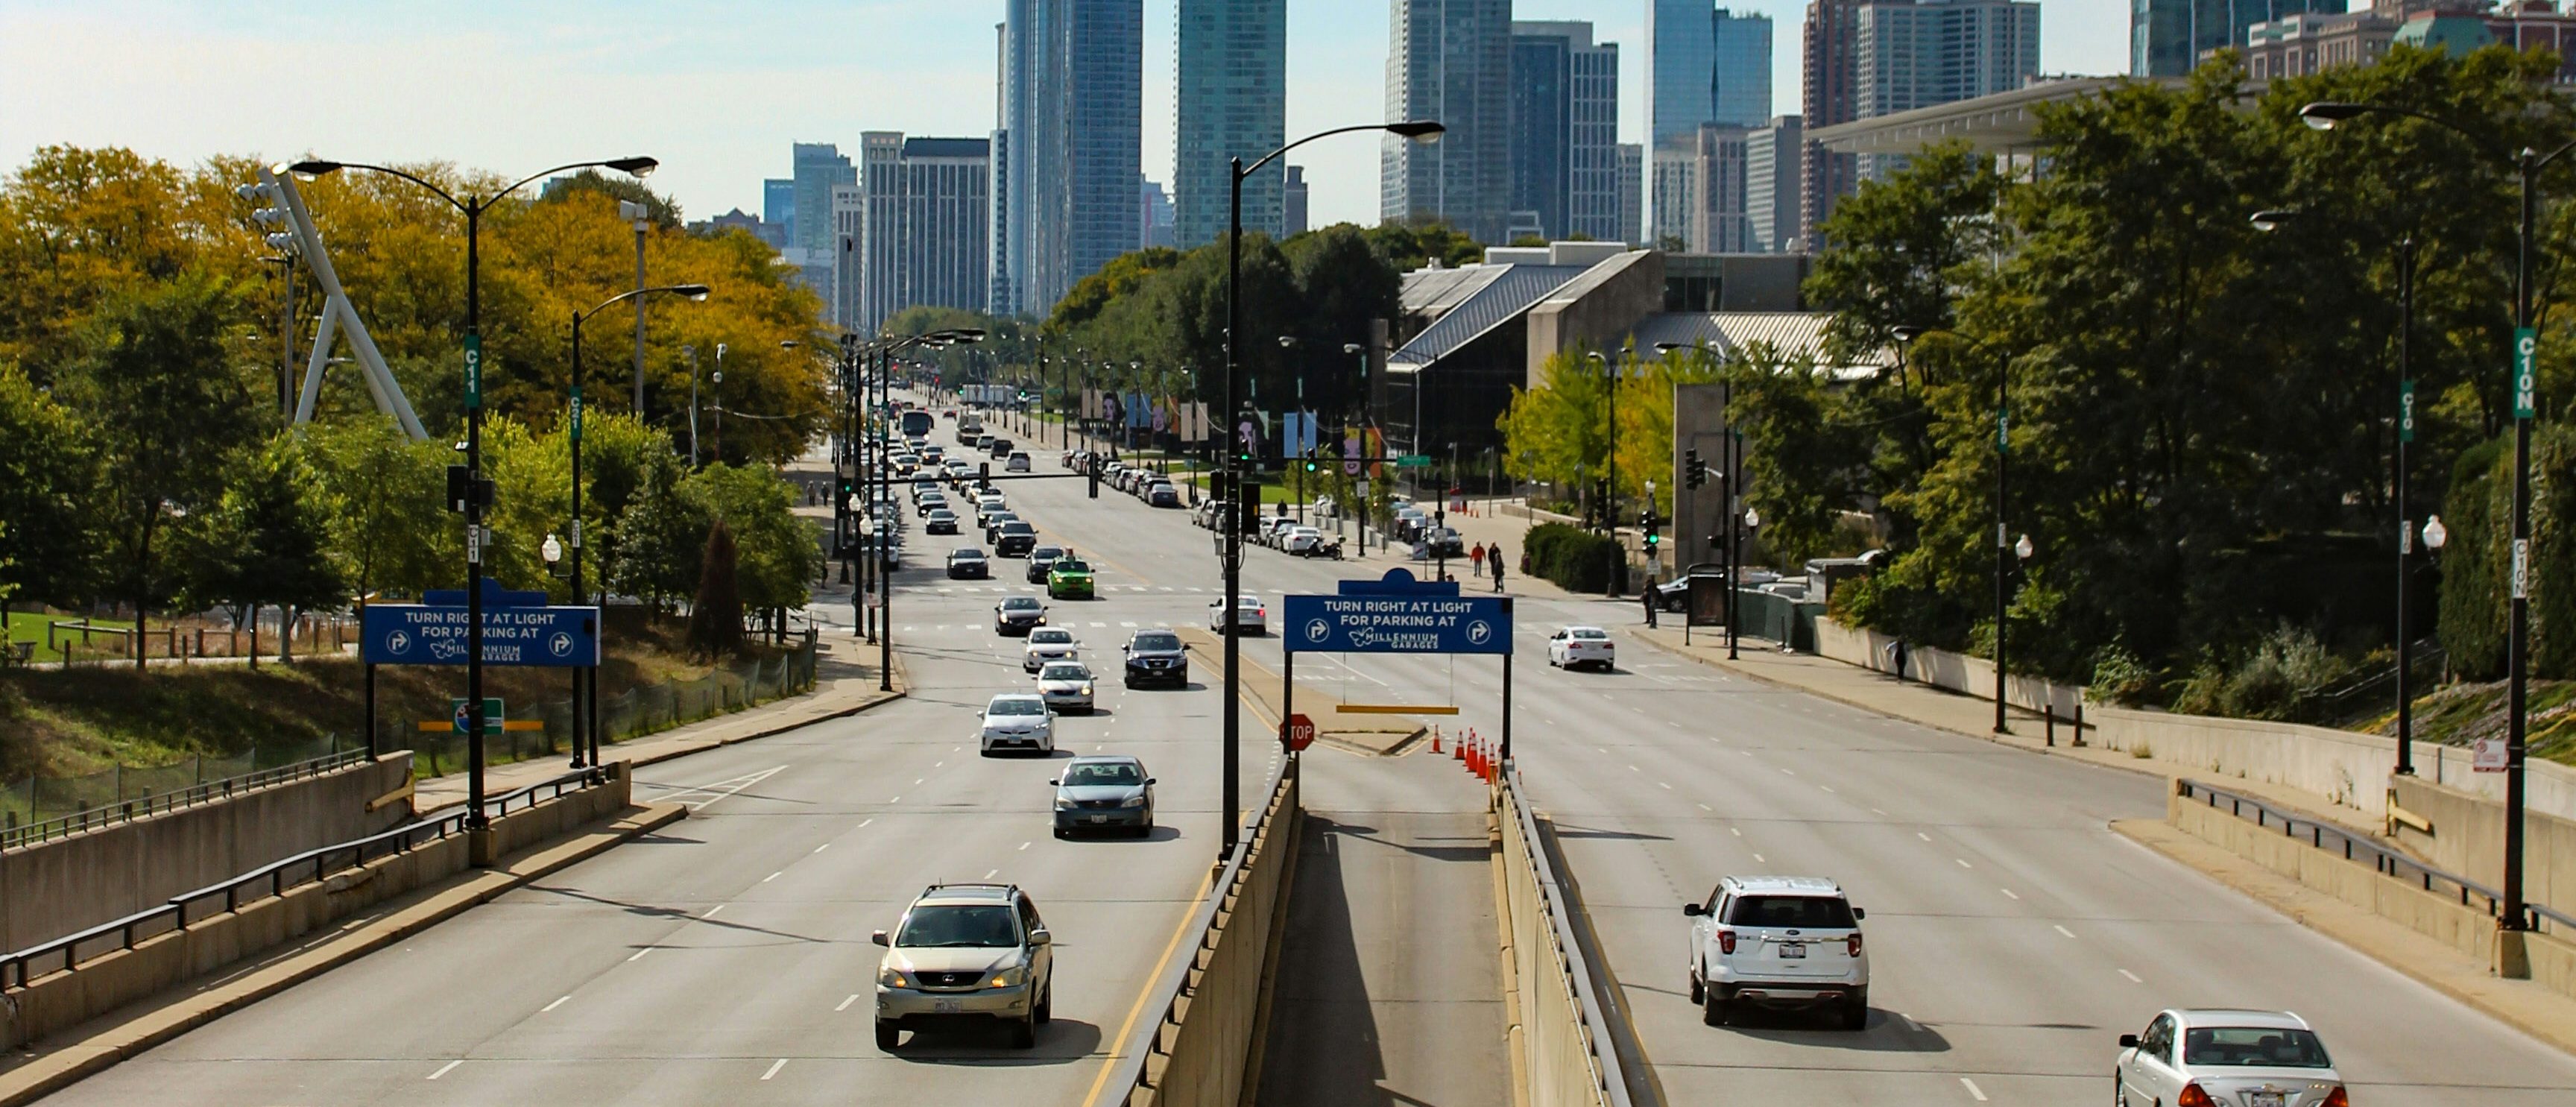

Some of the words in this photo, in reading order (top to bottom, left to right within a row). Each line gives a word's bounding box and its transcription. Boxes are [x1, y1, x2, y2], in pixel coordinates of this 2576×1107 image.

[465, 349, 479, 394] C11
[2517, 336, 2534, 410] C10N
[571, 397, 579, 430] C21
[2402, 392, 2414, 430] C10
[2515, 543, 2527, 596] C10N
[1324, 601, 1362, 612] TURN
[1366, 602, 1407, 612] RIGHT
[1410, 602, 1429, 613] AT
[1433, 602, 1473, 613] LIGHT
[405, 612, 443, 623] TURN
[447, 613, 488, 624] RIGT
[493, 614, 511, 624] AT
[515, 614, 555, 625] LIGHT
[1340, 615, 1368, 625] FOR
[1373, 615, 1434, 626] PARKING
[1438, 616, 1456, 627] AT
[421, 626, 450, 637] FOR
[454, 627, 516, 638] PAKING
[520, 628, 539, 638] AT
[1366, 633, 1439, 642] MILLENNIUM
[446, 645, 520, 654] MILNNIUM
[1391, 641, 1439, 649] GARAGES
[481, 653, 520, 661] ARAGES
